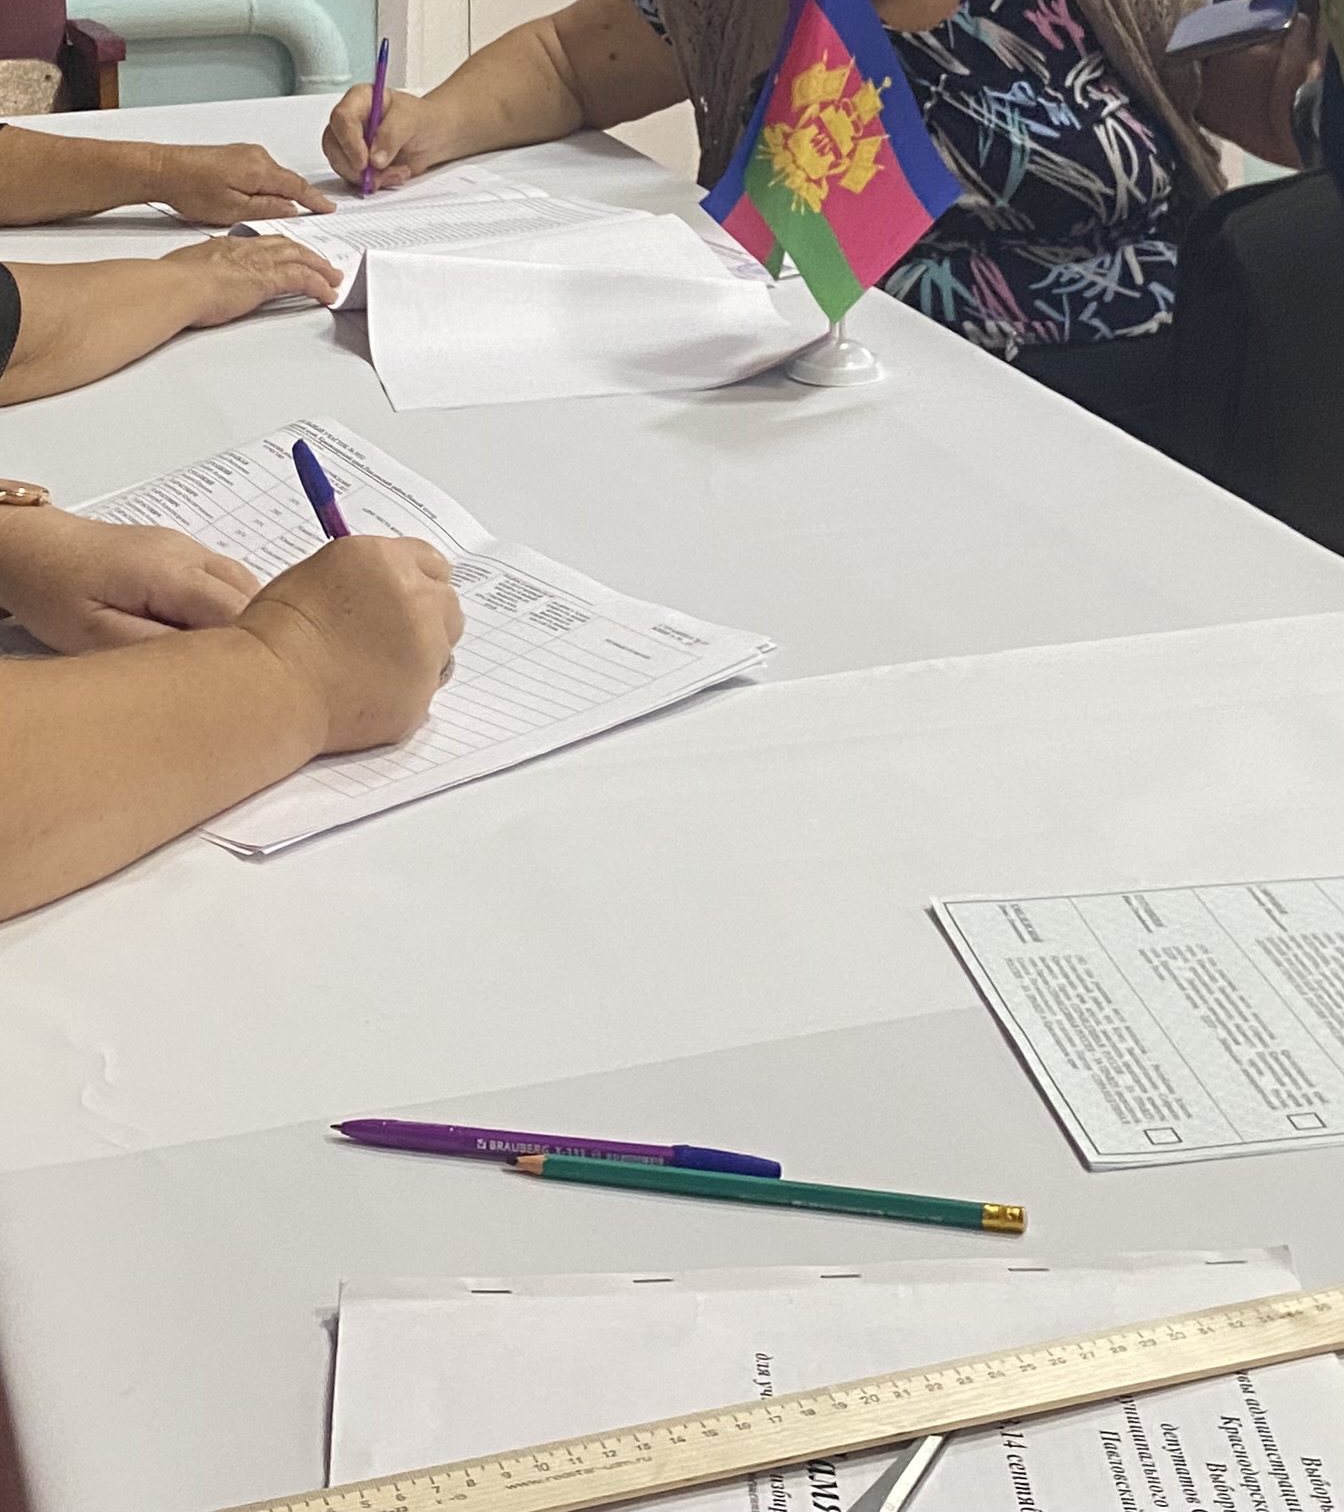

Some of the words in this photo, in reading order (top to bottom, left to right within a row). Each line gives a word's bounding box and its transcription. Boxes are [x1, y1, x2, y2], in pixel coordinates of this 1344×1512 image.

[489, 1140, 550, 1155] BRAUBERG
[755, 1352, 774, 1377] для
[360, 1500, 372, 1509] 5
[396, 1493, 406, 1502] 6
[431, 1486, 441, 1494] 7
[533, 1461, 551, 1473] 10
[568, 1455, 583, 1466] 11
[602, 1449, 617, 1459] 12
[669, 1436, 686, 1445] 14
[768, 1415, 783, 1424] 17
[859, 1393, 880, 1405] 20
[1160, 1423, 1201, 1504] депутатов
